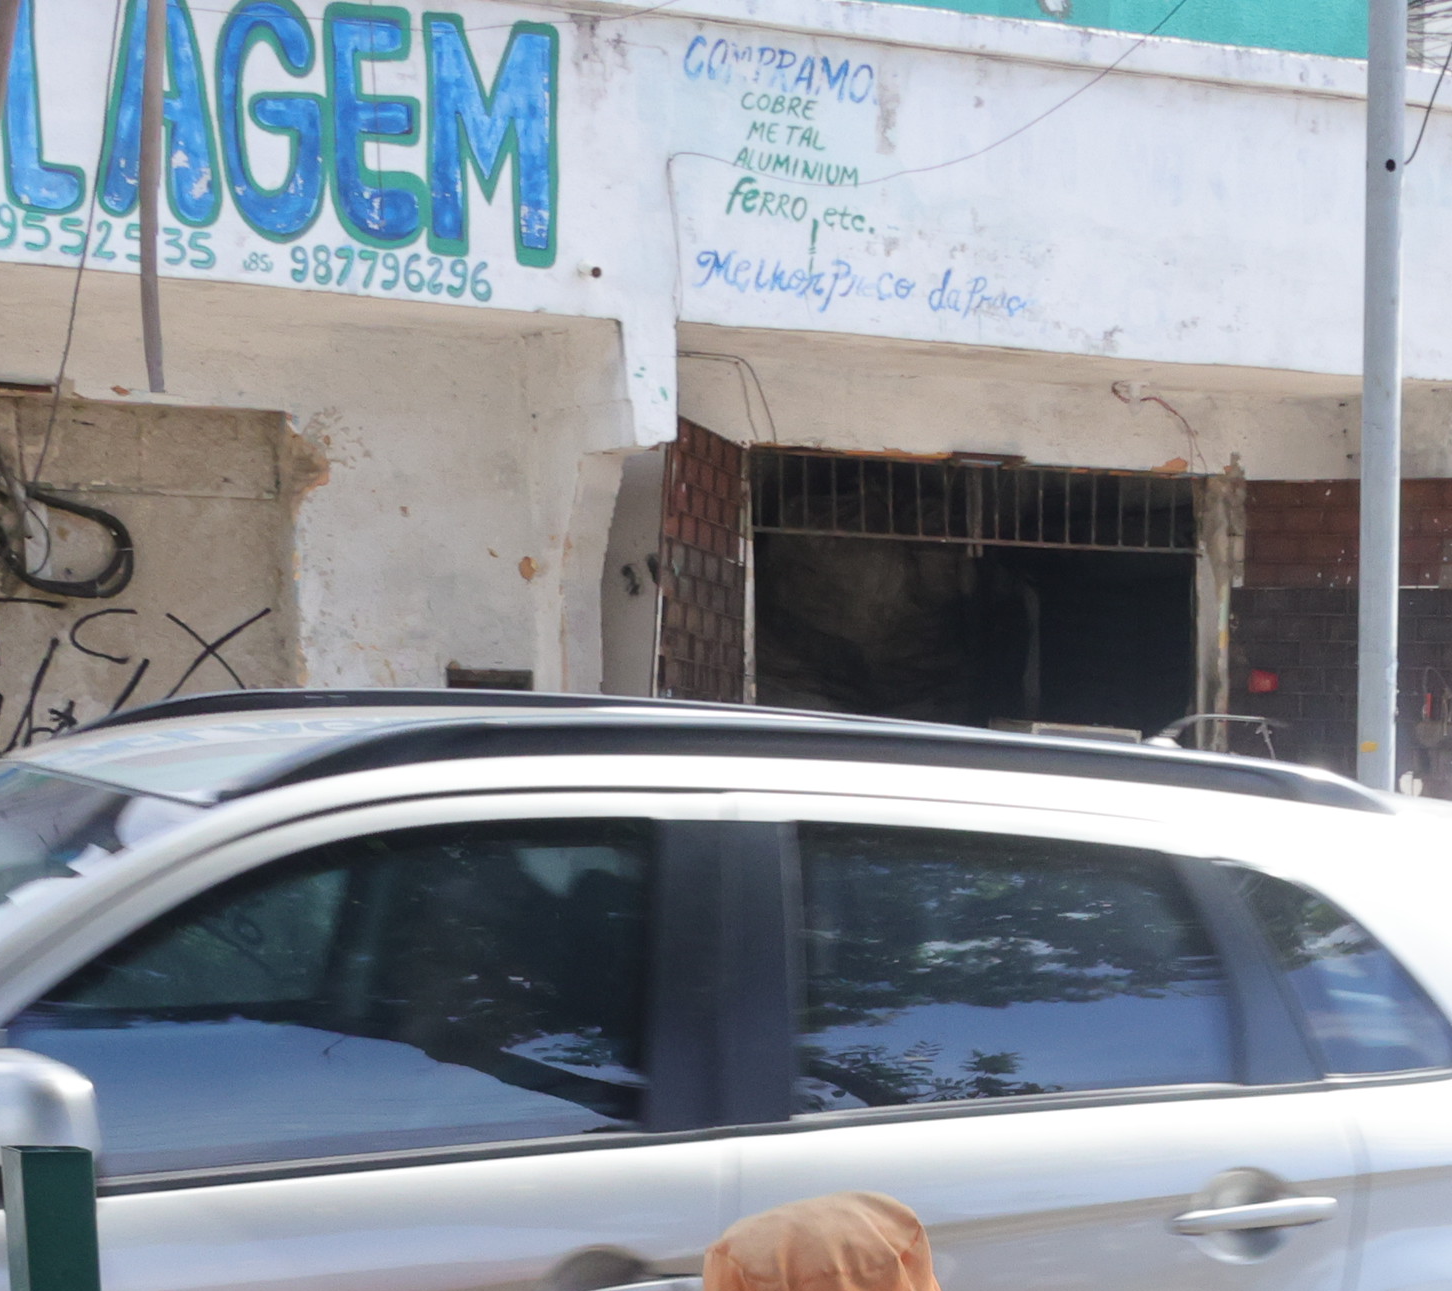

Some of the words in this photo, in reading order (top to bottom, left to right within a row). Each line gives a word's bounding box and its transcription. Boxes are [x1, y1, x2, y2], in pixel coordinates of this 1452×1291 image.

[683, 35, 879, 107] COMPRAMO
[741, 92, 818, 120] COBRE
[747, 120, 826, 150] METAL
[733, 146, 859, 187] ALUMINIUM
[290, 243, 493, 303] 987796296
